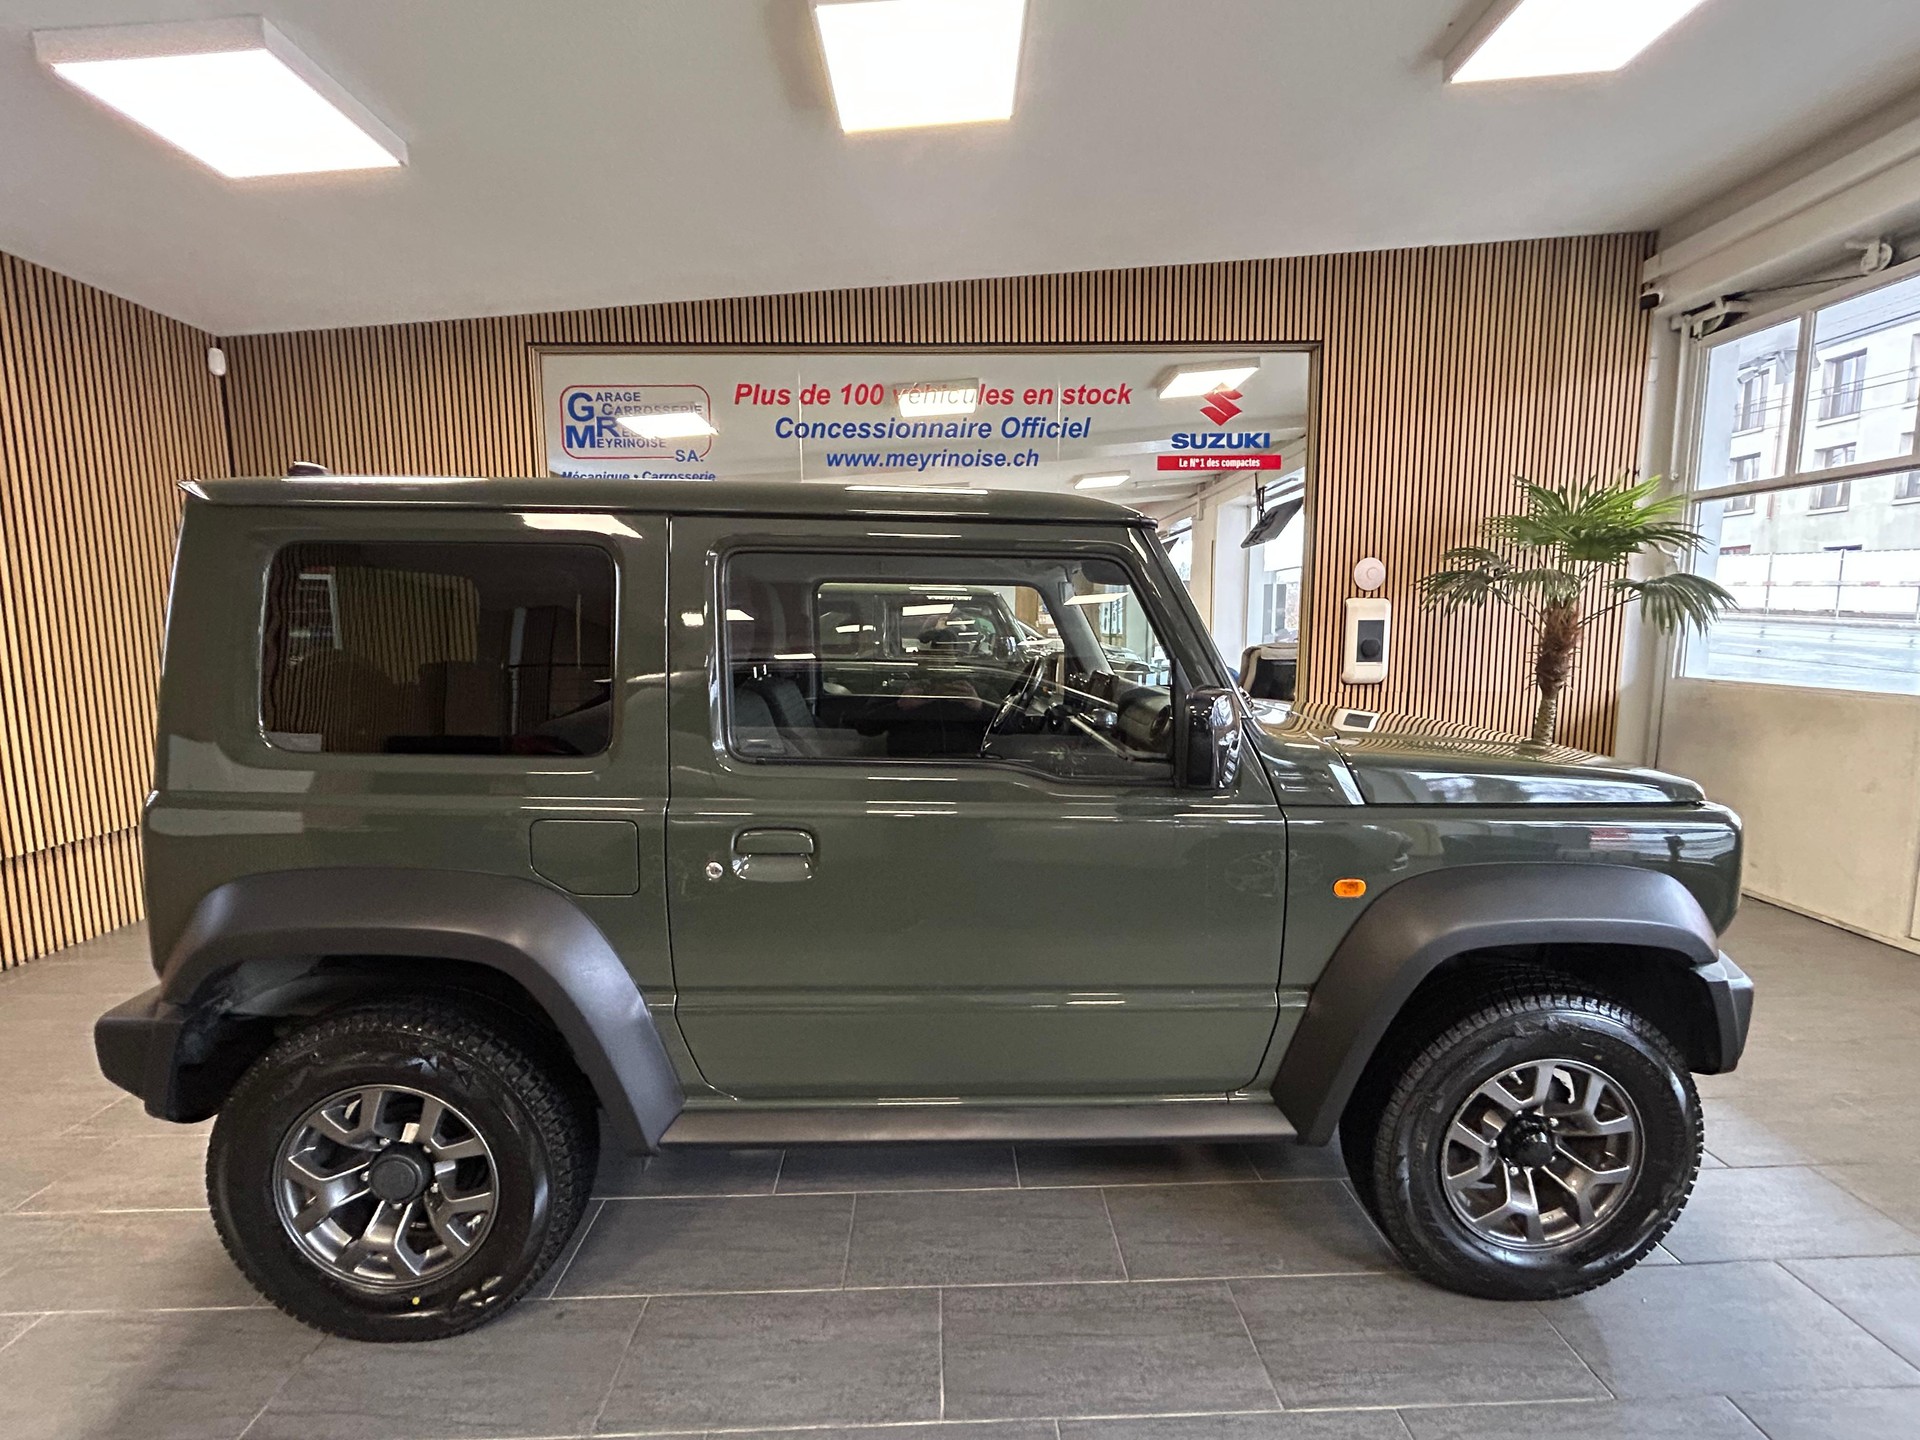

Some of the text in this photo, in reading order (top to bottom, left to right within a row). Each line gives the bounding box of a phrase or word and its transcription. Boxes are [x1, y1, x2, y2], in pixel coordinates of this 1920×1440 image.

[734, 382, 1133, 406] Plus de 100 véhicules en stock
[567, 391, 641, 422] GARAGE
[565, 425, 667, 449] MEYRINOISE
[775, 416, 1092, 439] Concessionnaire Officiel
[1171, 432, 1271, 449] SUZUKI
[826, 448, 1039, 472] www.meyrinoise.ch
[1179, 457, 1188, 468] Le
[1206, 457, 1220, 467] des
[1221, 457, 1261, 468] compactes
